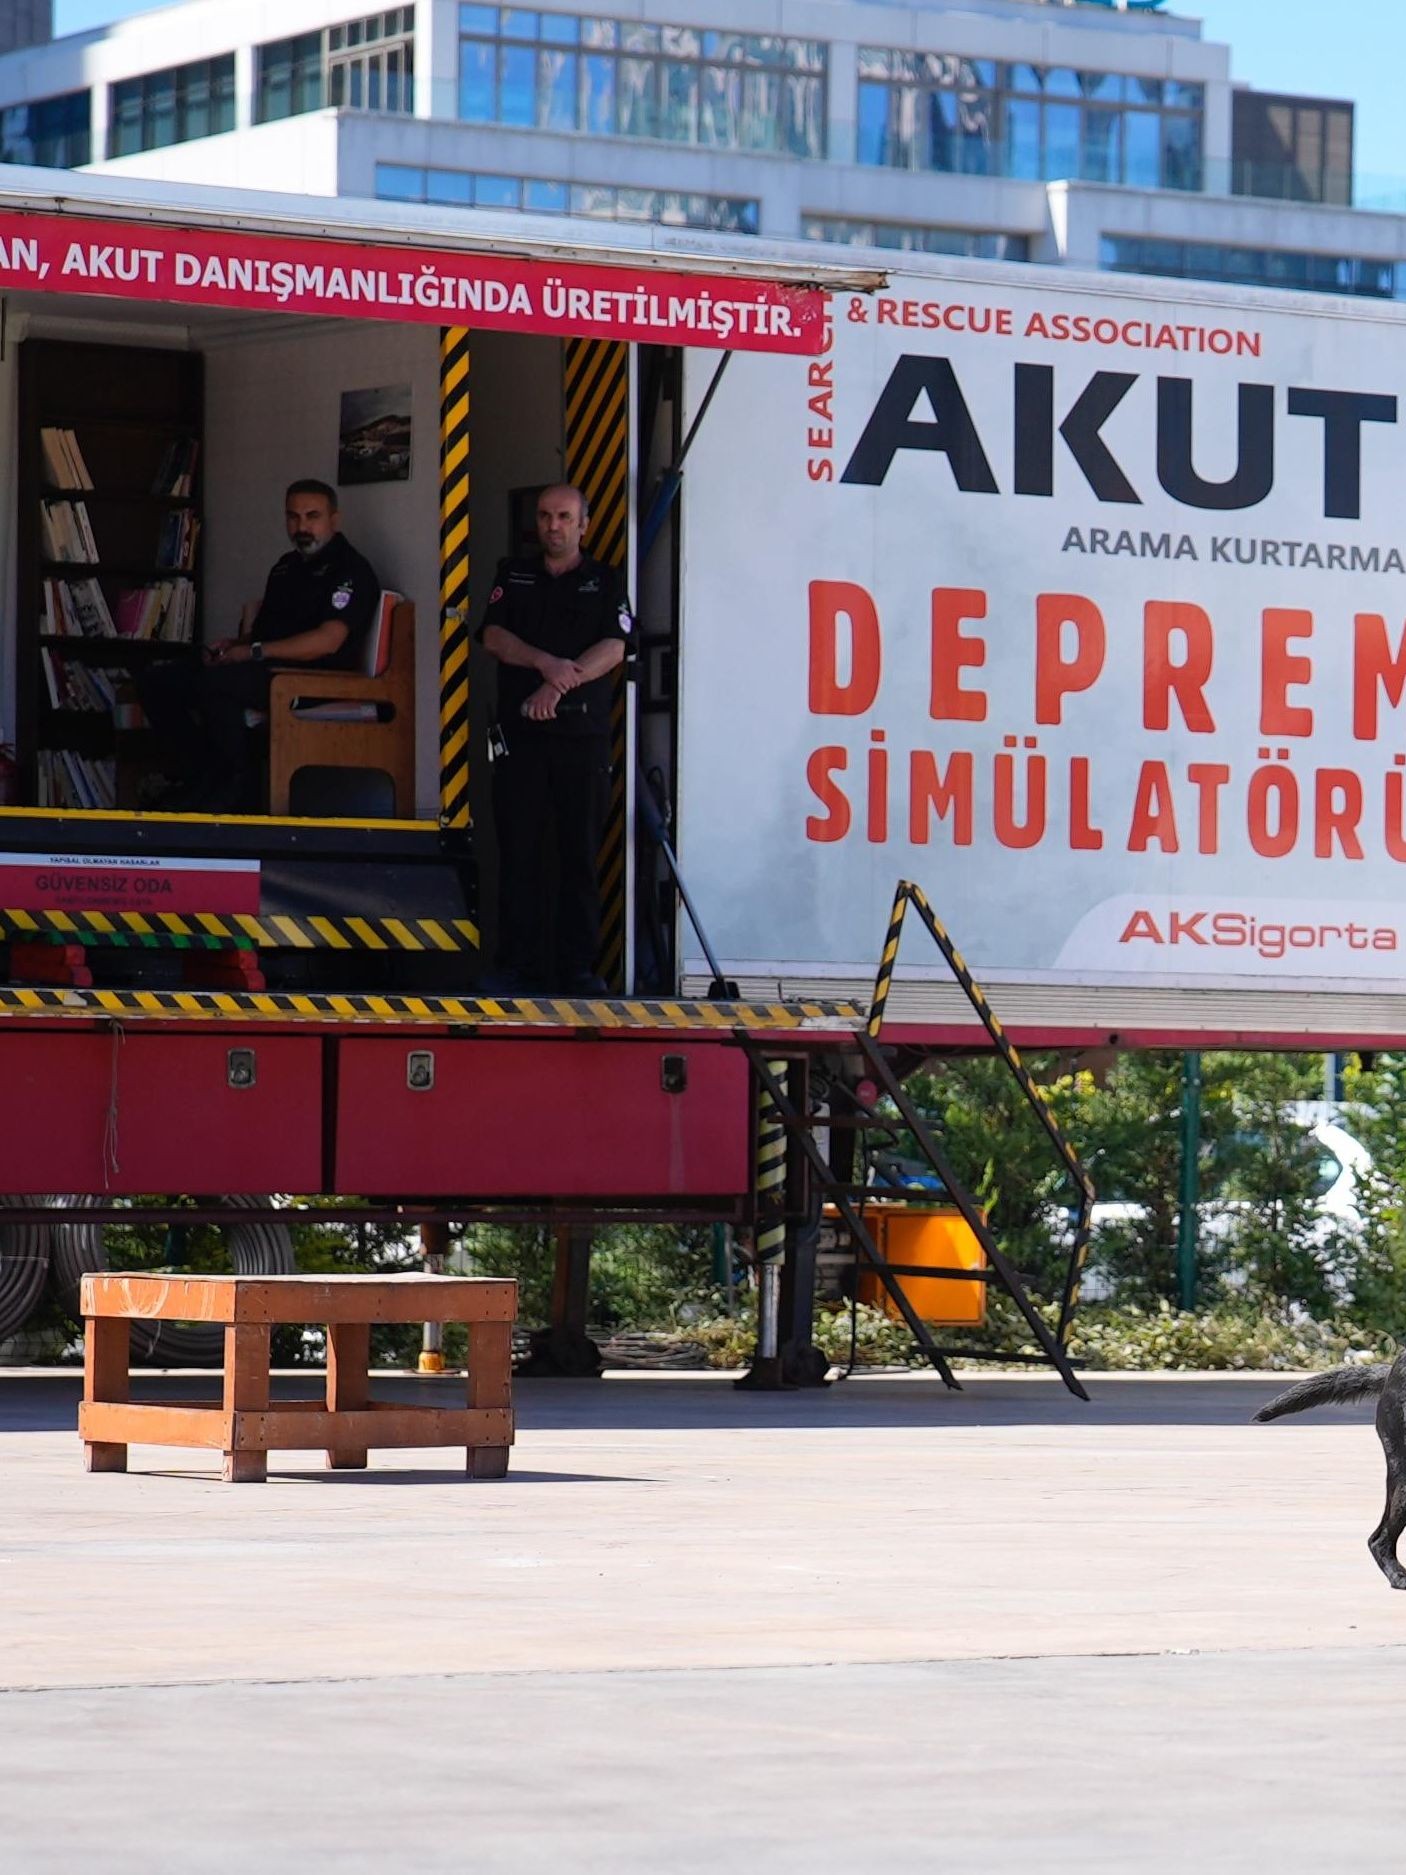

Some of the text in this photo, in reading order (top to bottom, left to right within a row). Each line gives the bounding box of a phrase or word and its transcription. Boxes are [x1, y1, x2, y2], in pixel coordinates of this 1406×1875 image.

[61, 242, 164, 284] AKUT
[174, 252, 534, 316] DANIŞMANLIĞINDA
[542, 277, 802, 340] ÜRETİLMİŞTİR.
[847, 296, 1262, 358] & RESCUE ASSOCIATION
[839, 353, 1398, 521] AKUT
[1061, 525, 1406, 575] ARAMA KURTARMA
[35, 871, 173, 895] GÜVENSİZ ODA
[1118, 909, 1398, 959] AKSigorta
